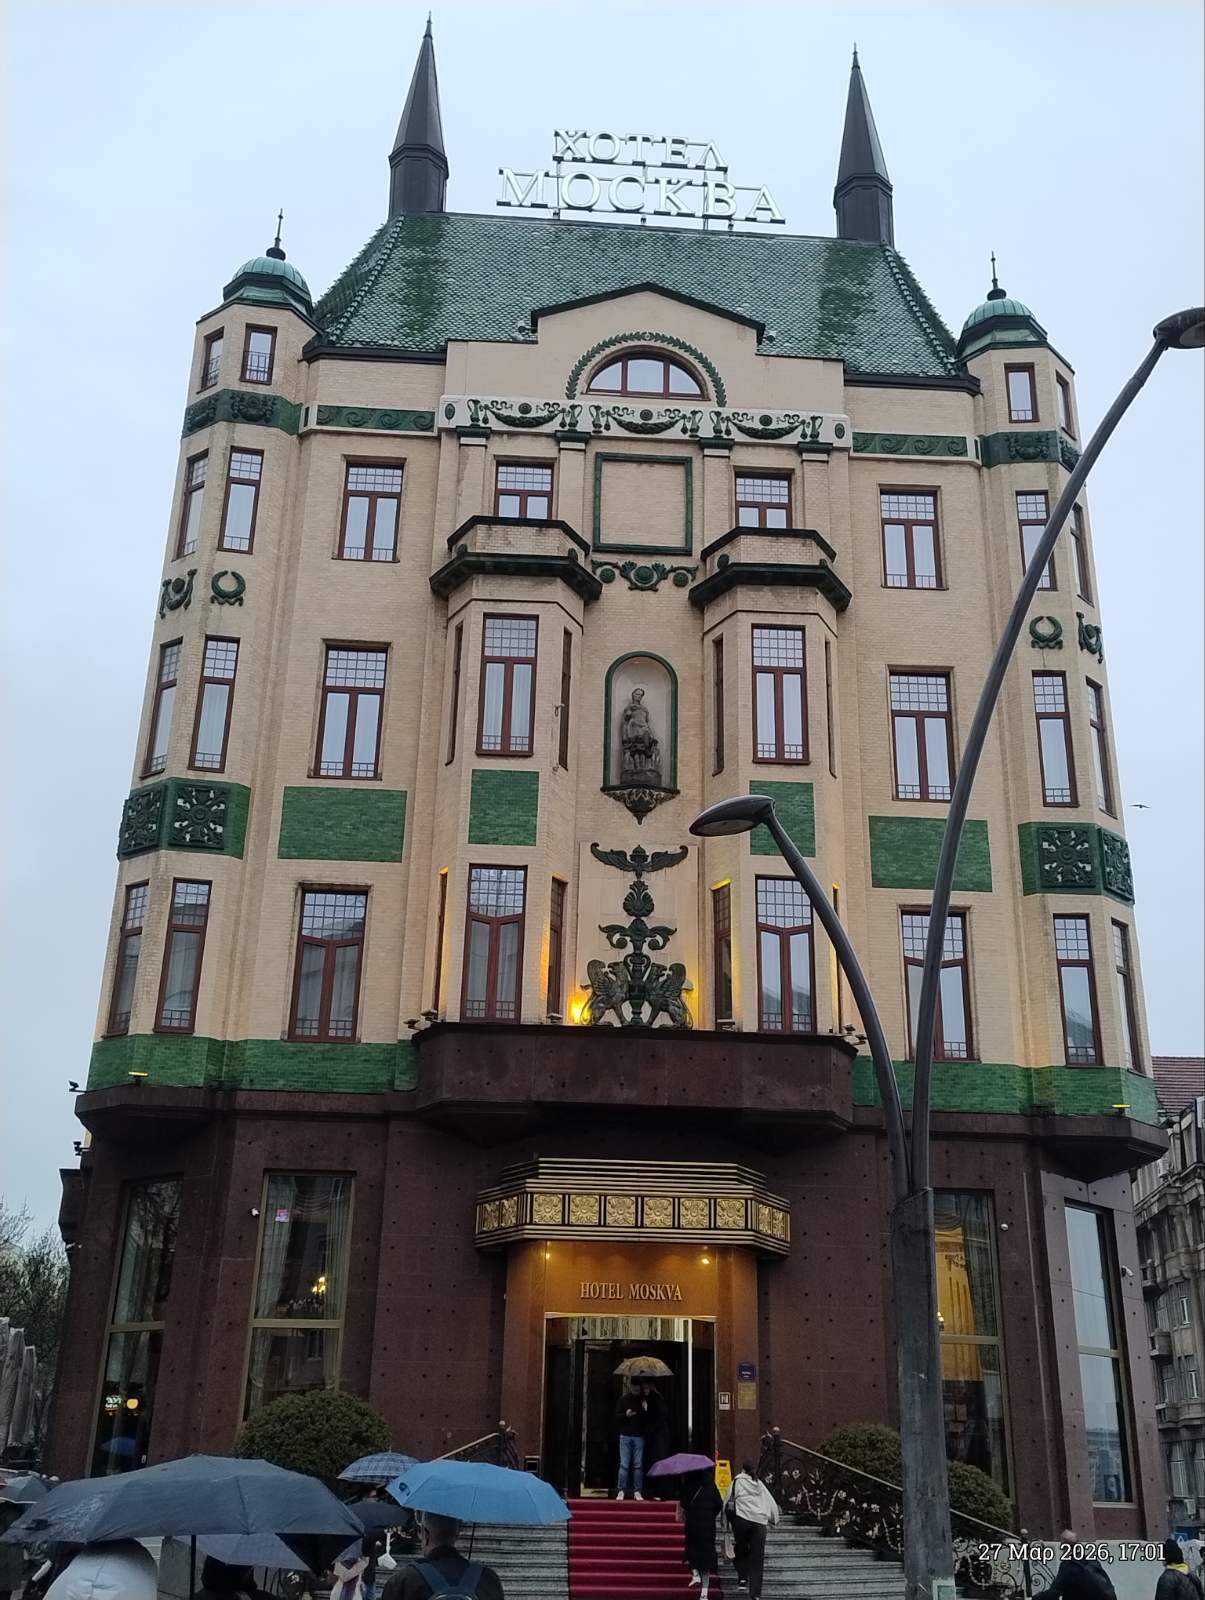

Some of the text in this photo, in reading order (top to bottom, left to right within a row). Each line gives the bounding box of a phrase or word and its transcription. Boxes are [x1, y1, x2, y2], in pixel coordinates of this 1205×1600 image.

[552, 128, 728, 171] ХОТЕЛ
[496, 168, 786, 225] МОСКВА
[580, 1282, 682, 1301] HOTEL MOSKVA
